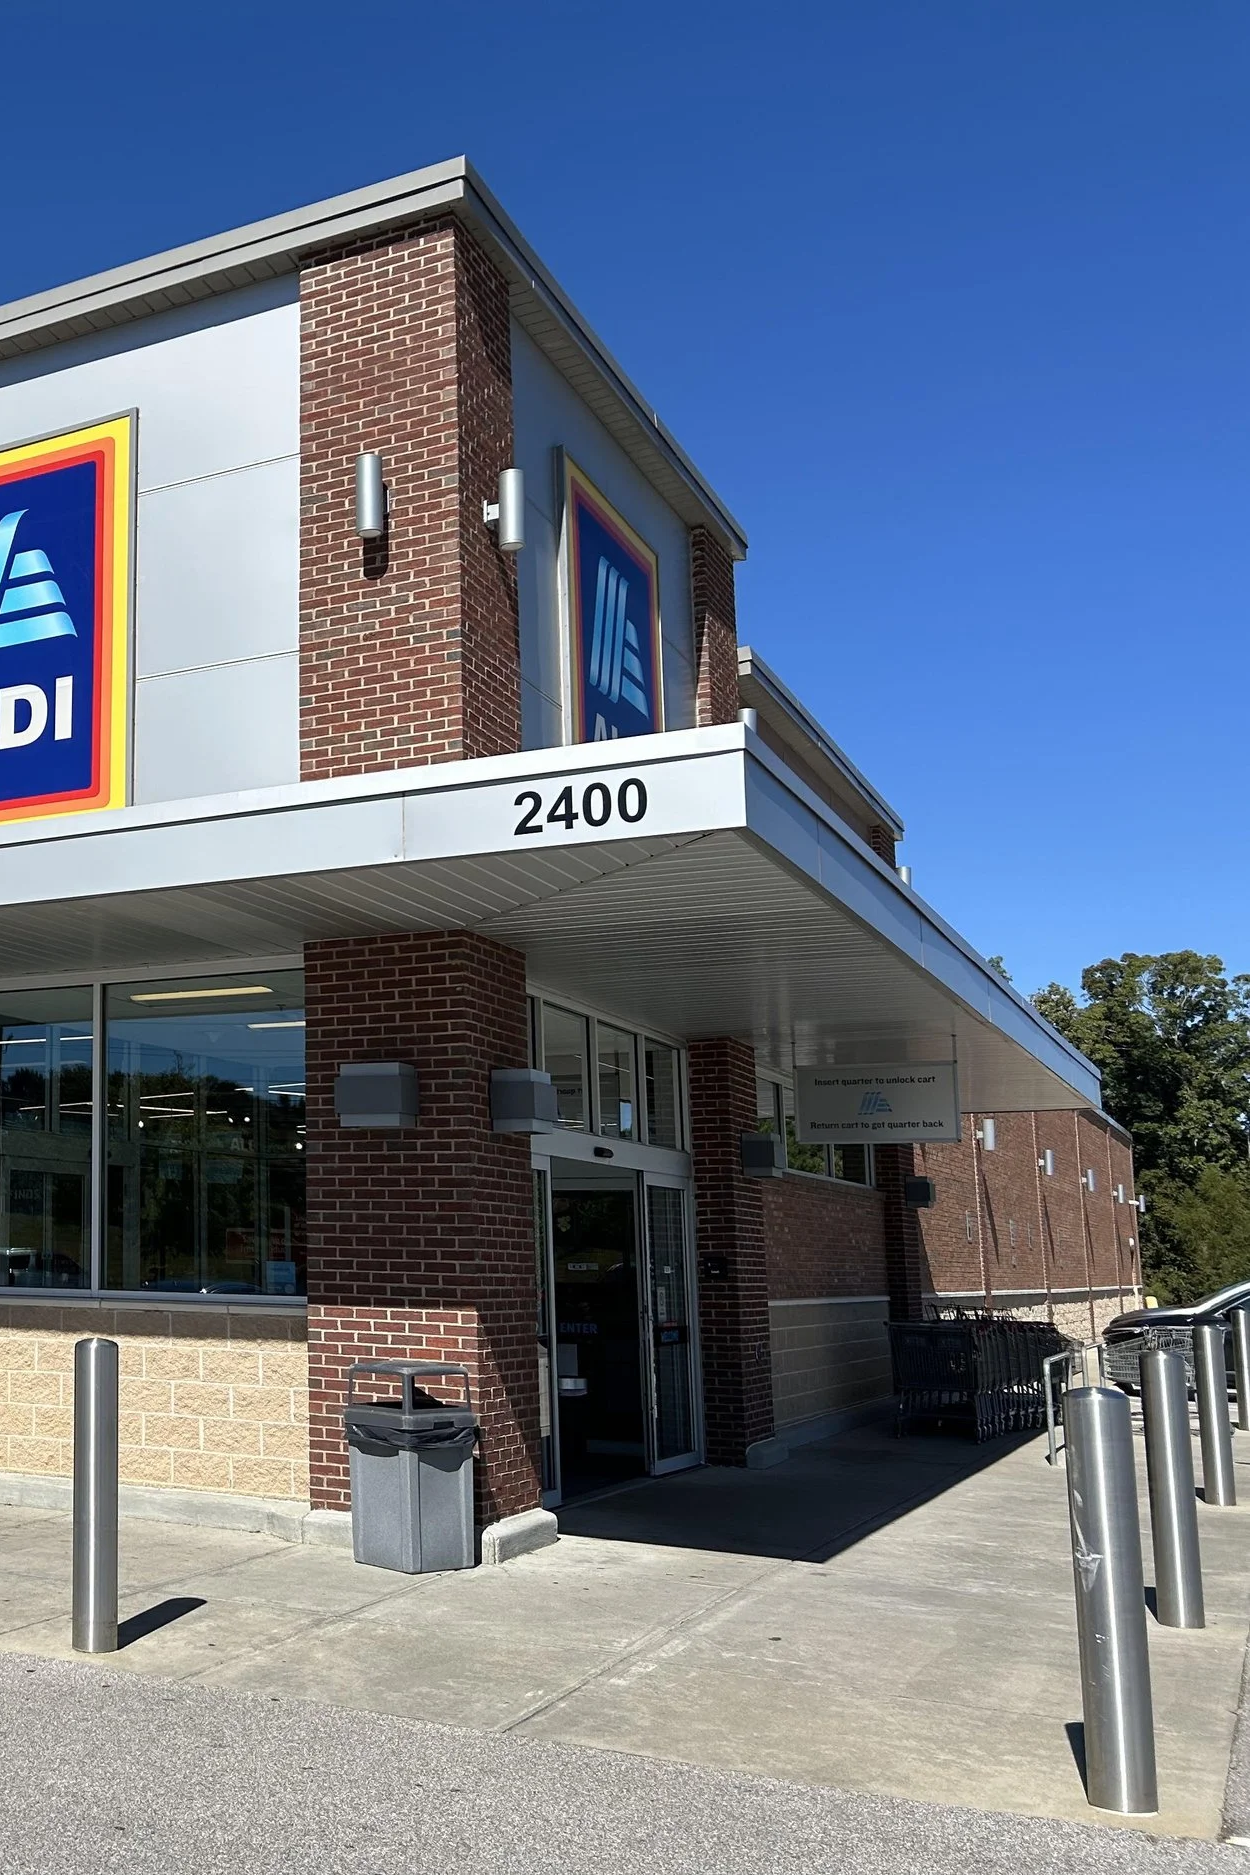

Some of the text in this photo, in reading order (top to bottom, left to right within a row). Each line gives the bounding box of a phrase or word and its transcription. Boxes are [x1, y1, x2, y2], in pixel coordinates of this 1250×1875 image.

[513, 777, 648, 836] 2400
[814, 1075, 936, 1087] Insert quarter to unlock cart
[810, 1119, 944, 1130] Return cart to get quarter back
[559, 1321, 598, 1335] ENTER
